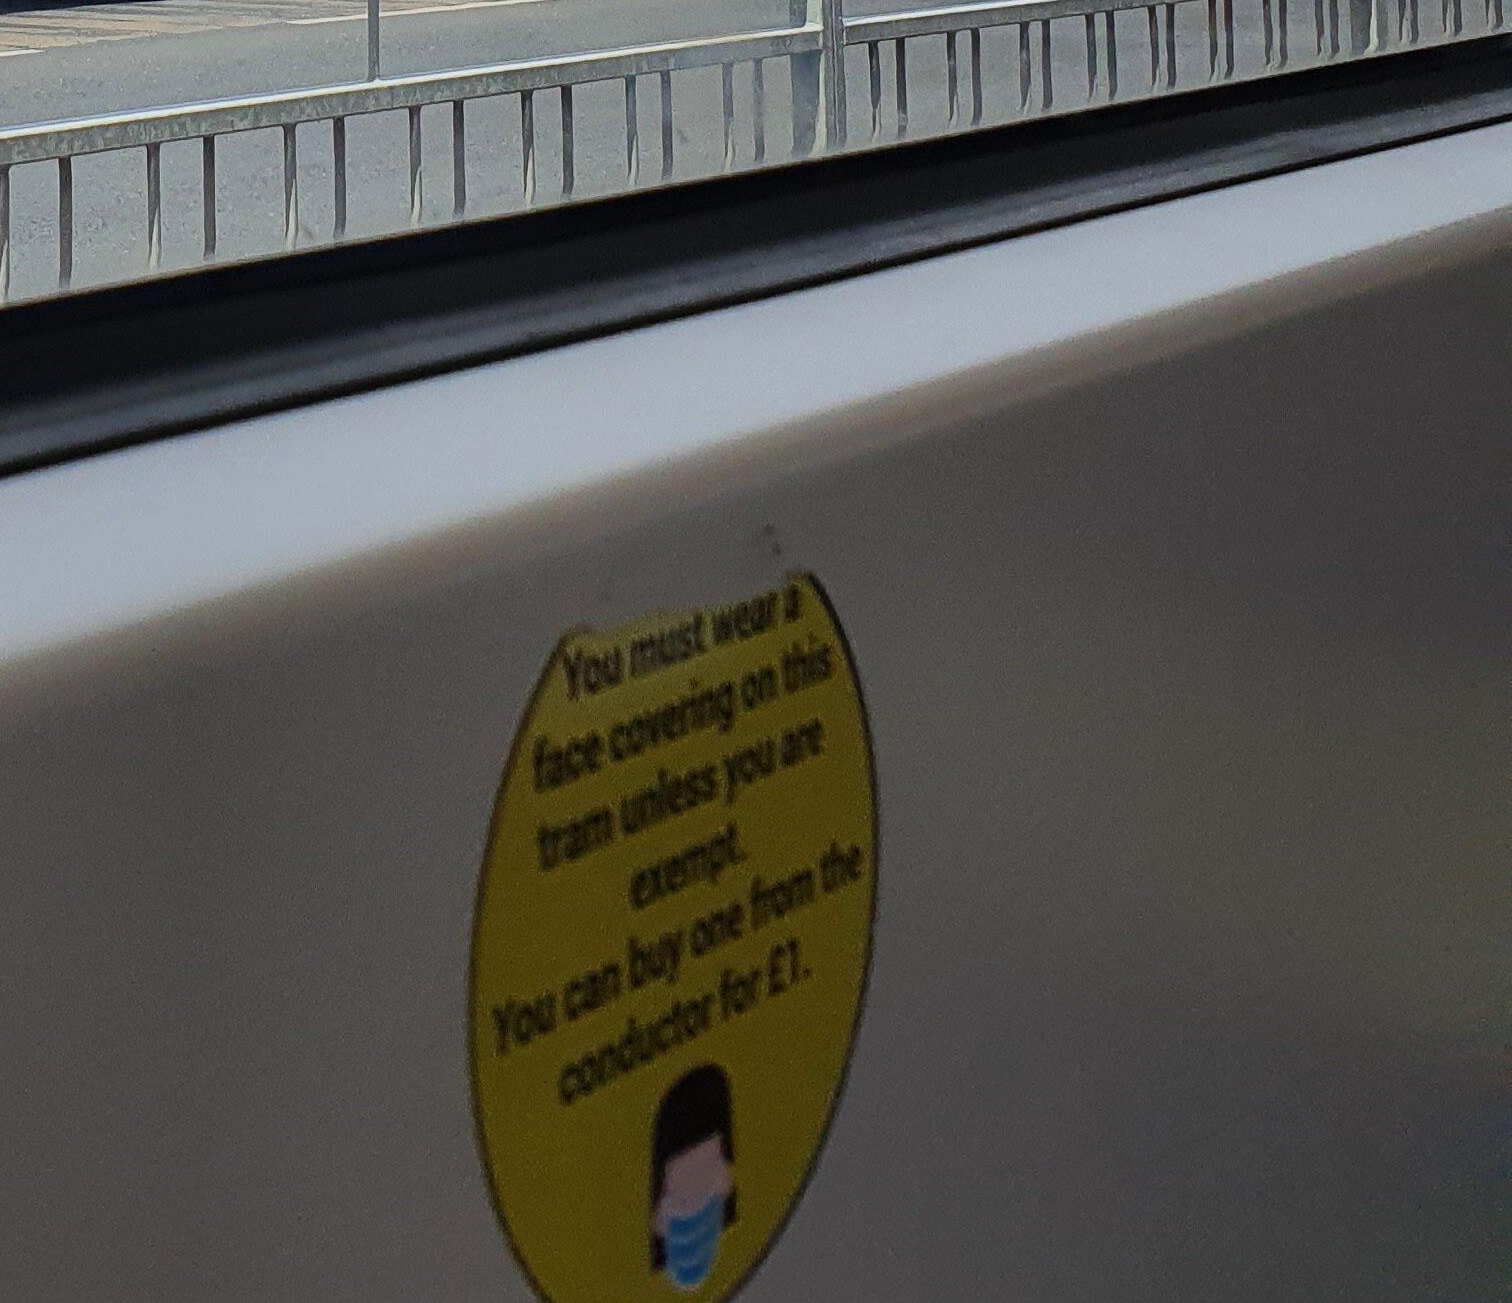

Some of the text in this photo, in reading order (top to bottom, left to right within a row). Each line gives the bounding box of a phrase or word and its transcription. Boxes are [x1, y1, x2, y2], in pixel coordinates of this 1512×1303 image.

[531, 632, 834, 795] face covering on this
[562, 645, 622, 702] You
[628, 612, 707, 678] must
[711, 590, 779, 647] wear
[536, 716, 824, 873] tram unless you are
[628, 821, 748, 911] exempt.
[491, 838, 864, 1057] You can buy one from the
[556, 993, 715, 1106] conductor
[717, 967, 763, 1022] for
